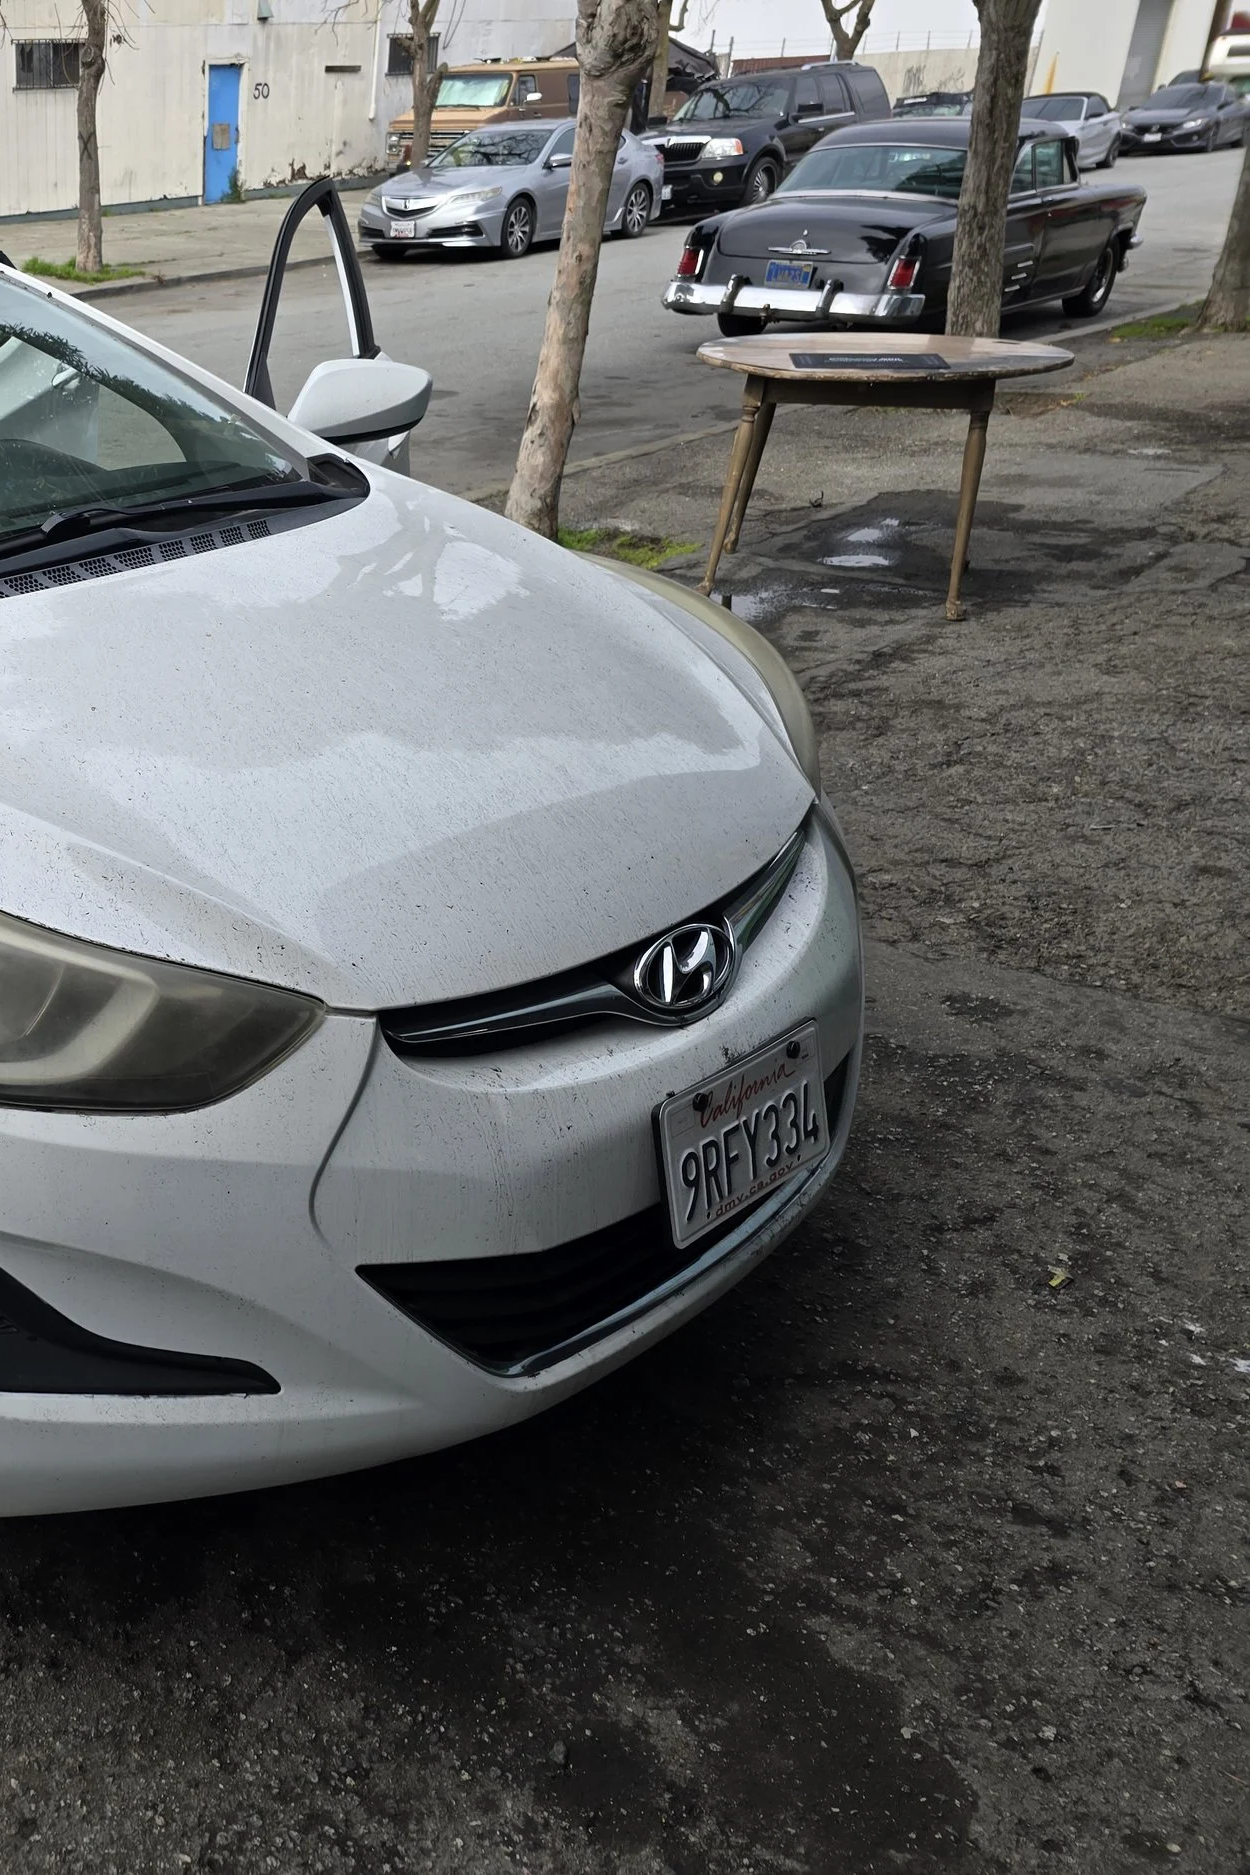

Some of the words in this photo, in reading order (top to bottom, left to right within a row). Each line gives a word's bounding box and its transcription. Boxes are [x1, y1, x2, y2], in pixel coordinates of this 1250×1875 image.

[253, 82, 270, 99] 50
[701, 1059, 796, 1129] California
[680, 1079, 820, 1223] 9RFY334
[715, 1160, 795, 1218] dmv.ca.gov
